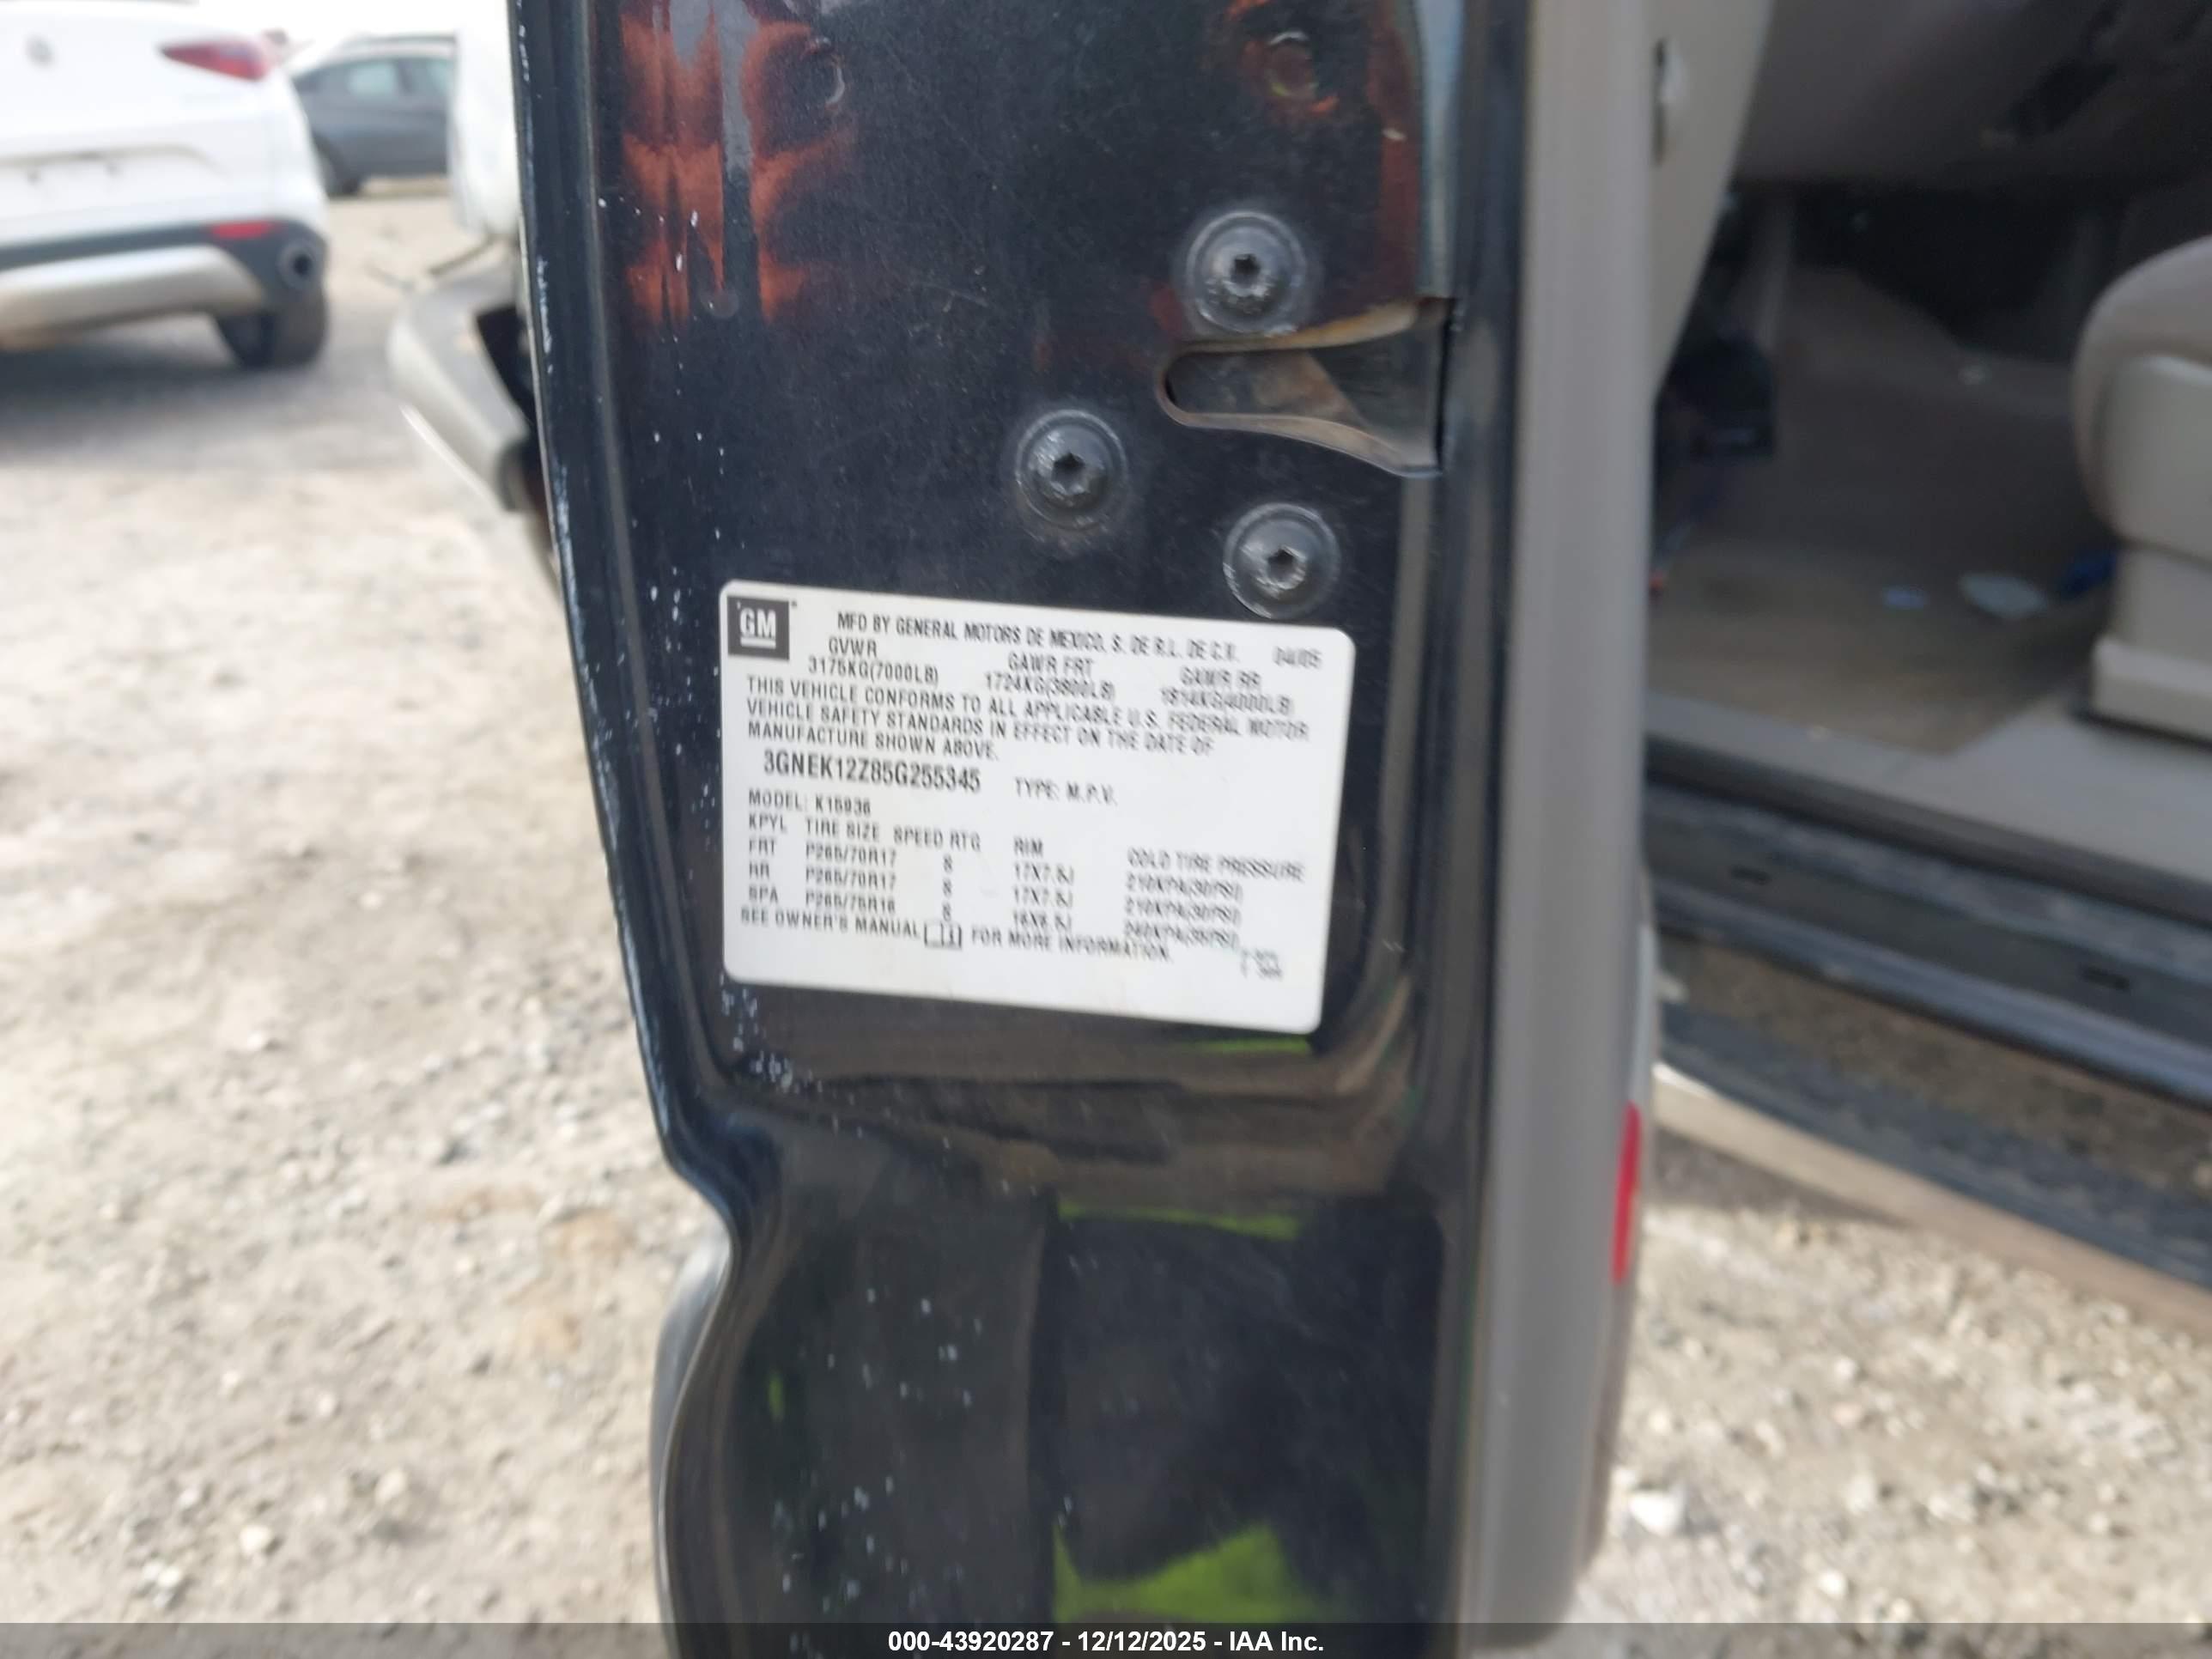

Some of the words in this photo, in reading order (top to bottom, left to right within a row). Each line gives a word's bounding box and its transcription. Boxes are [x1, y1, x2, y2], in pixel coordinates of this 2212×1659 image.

[739, 608, 776, 639] GM
[837, 611, 867, 631] MFD
[872, 616, 890, 634] BY
[896, 617, 957, 640] GENERAL
[965, 623, 1019, 645] MOTORS
[1027, 626, 1045, 647] DE
[1130, 635, 1149, 655] DE
[829, 637, 877, 657] GVWR
[808, 657, 939, 685] 3175KG(7000LB)
[1008, 652, 1056, 673] GAWR
[1063, 658, 1094, 678] FRT
[748, 676, 784, 695] THIS
[791, 679, 857, 702] VEHICLE
[866, 685, 954, 710] CONFORMS
[963, 696, 981, 713] TO
[989, 697, 1016, 717] ALL
[1025, 701, 1121, 726] APPLICABLE
[1127, 708, 1160, 727] U.S.
[1168, 712, 1240, 736] FEDERAL
[1247, 720, 1309, 740] MOTOR
[748, 700, 813, 721] VEHICLE
[821, 705, 880, 726] SAFETY
[886, 713, 982, 734] STANDARDS
[990, 721, 1006, 738] IN
[1014, 720, 1071, 743] EFFECT
[1078, 726, 1099, 746] ON
[1107, 729, 1138, 750] THE
[1145, 733, 1185, 754] DATE
[1191, 738, 1214, 756] OF
[749, 721, 867, 747] MANUFACTURE
[875, 729, 935, 755] SHOWN
[943, 738, 999, 762] ABOVE.
[763, 750, 981, 792] 3GNEK12Z85G255345
[749, 789, 807, 811] MODEL:
[815, 794, 871, 817] K15936
[1066, 781, 1117, 806] M.P.V.
[749, 814, 787, 832] KPYL
[805, 818, 839, 836] TIRE
[847, 822, 880, 840] SIZE
[749, 839, 776, 854] FRT
[893, 826, 943, 847] SPEED
[951, 830, 981, 851] RTG
[1014, 836, 1042, 856] RIM
[805, 842, 896, 864] P265/70R17
[1127, 848, 1169, 870] COLD
[1176, 852, 1212, 872] TIRE
[1218, 855, 1304, 881] PRESSURE
[749, 863, 769, 878] RR
[805, 867, 896, 890] P265/70R17
[749, 886, 778, 903] SPA
[741, 907, 769, 924] SEE
[775, 911, 848, 931] OWNER'S
[856, 918, 921, 939] MANUAL
[972, 929, 1002, 945] FOR
[1009, 931, 1051, 951] MORE
